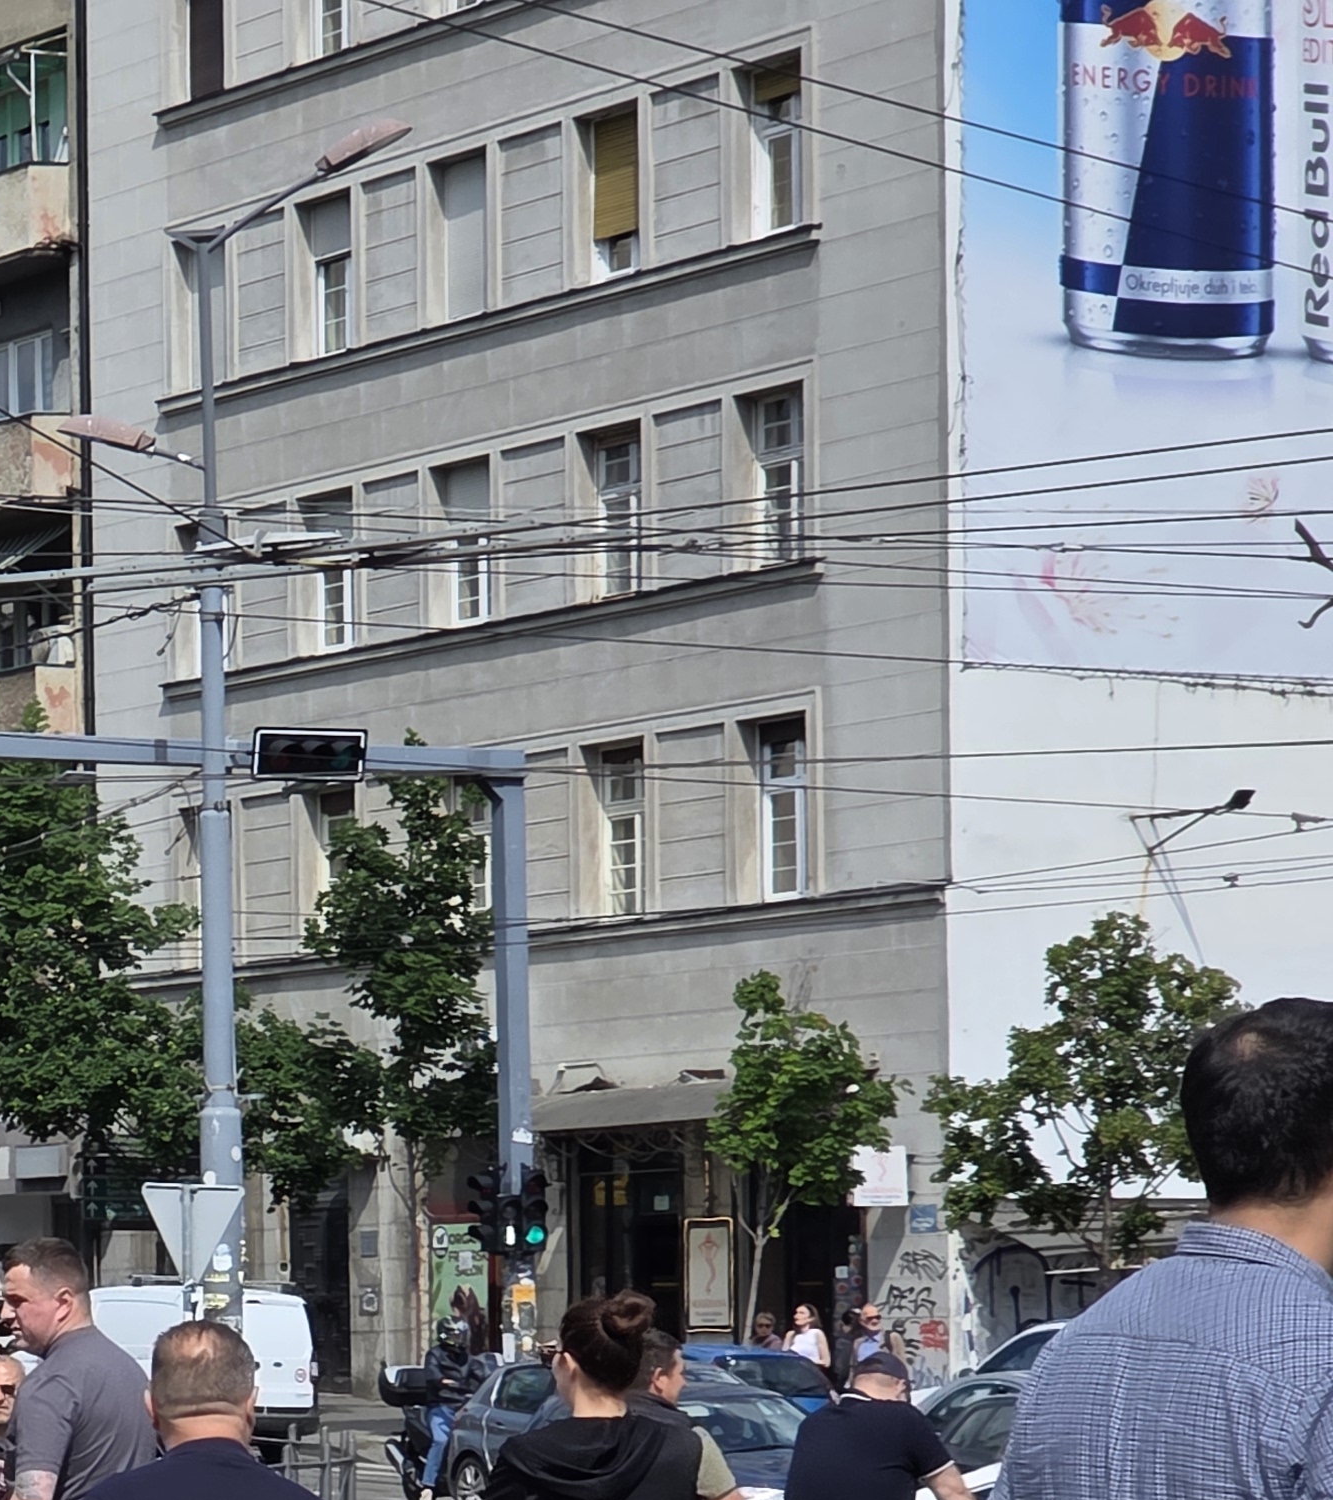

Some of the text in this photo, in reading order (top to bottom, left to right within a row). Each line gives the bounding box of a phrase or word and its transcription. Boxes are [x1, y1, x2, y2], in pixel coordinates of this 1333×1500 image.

[1070, 62, 1171, 95] ENERGY
[1304, 83, 1330, 198] Bull
[1125, 273, 1200, 298] Okrepljuje
[1304, 208, 1330, 328] Red
